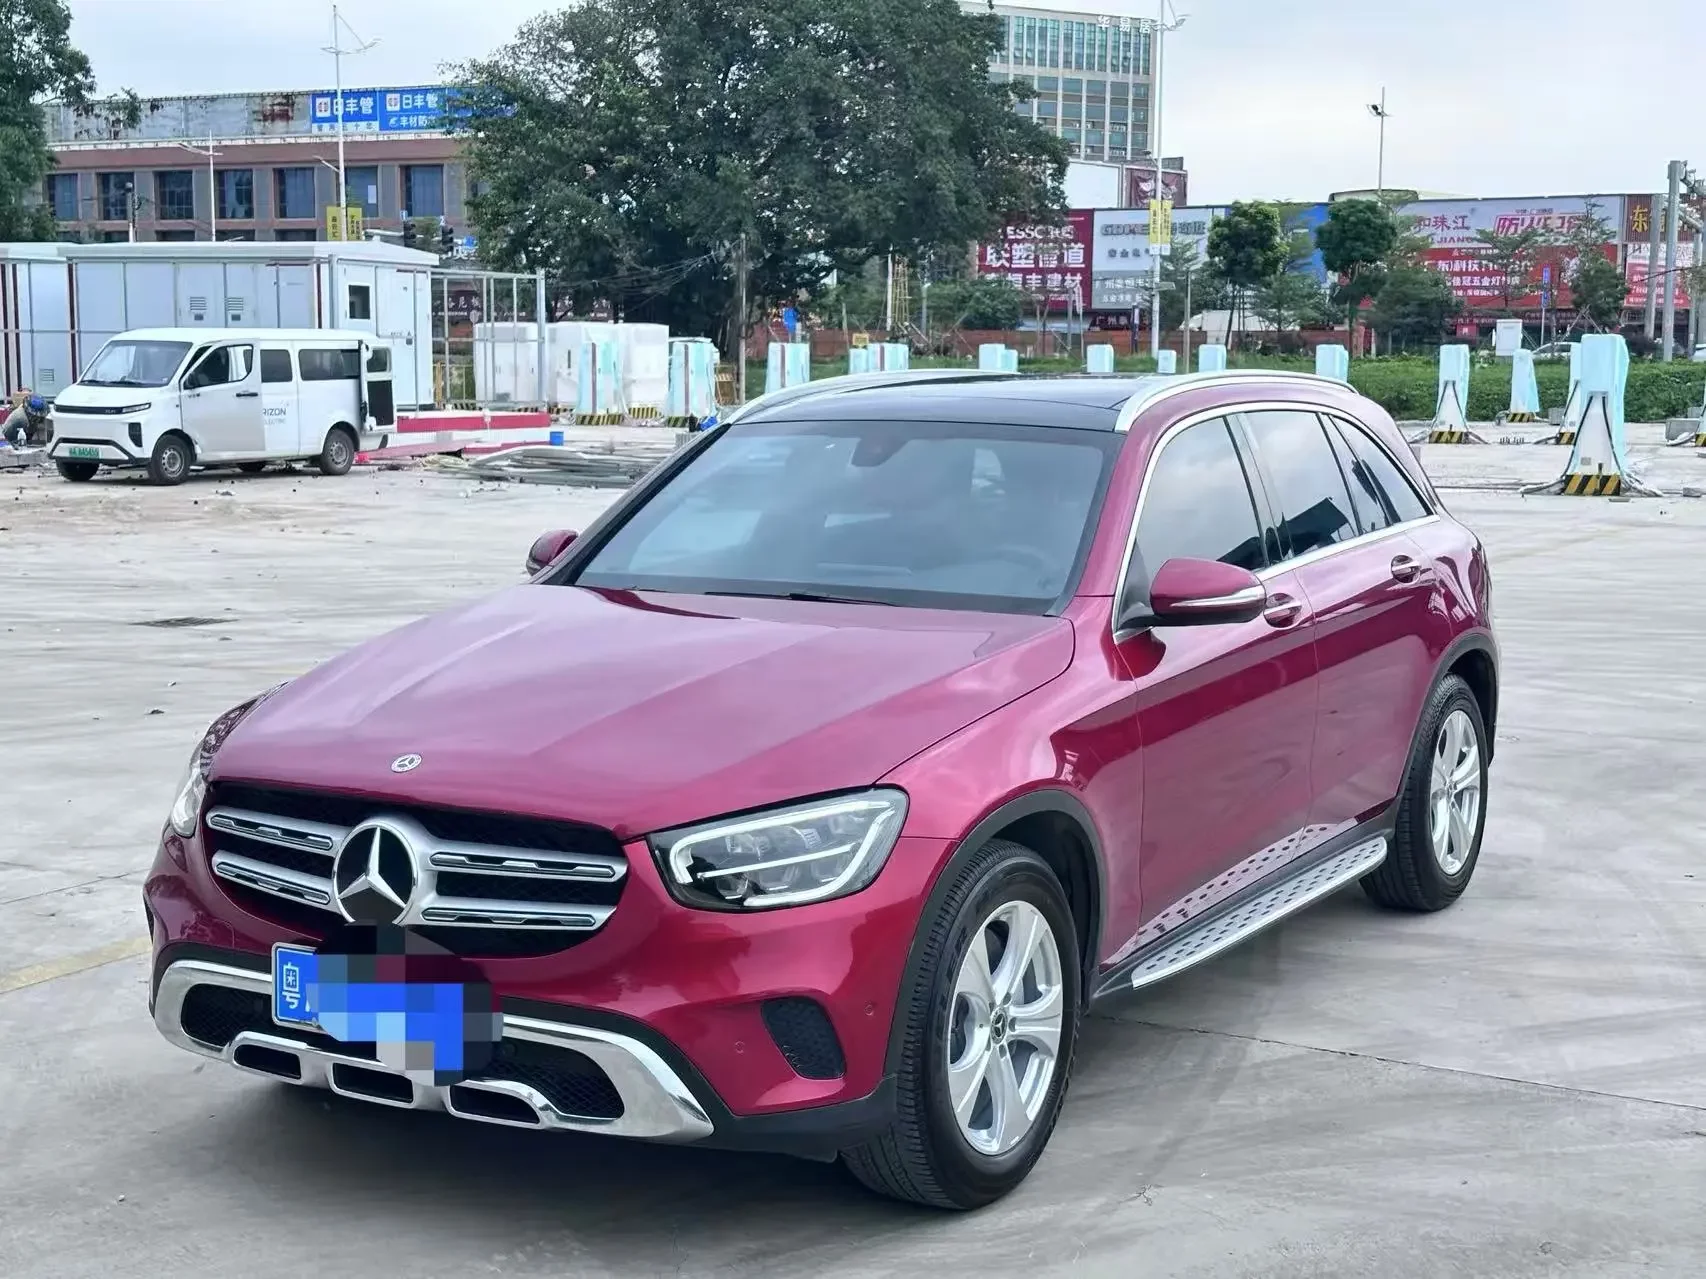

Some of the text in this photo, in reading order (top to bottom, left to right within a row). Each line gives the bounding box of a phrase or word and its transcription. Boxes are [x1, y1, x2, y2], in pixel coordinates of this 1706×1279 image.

[333, 97, 374, 115] 日丰管
[402, 93, 438, 109] 日丰管
